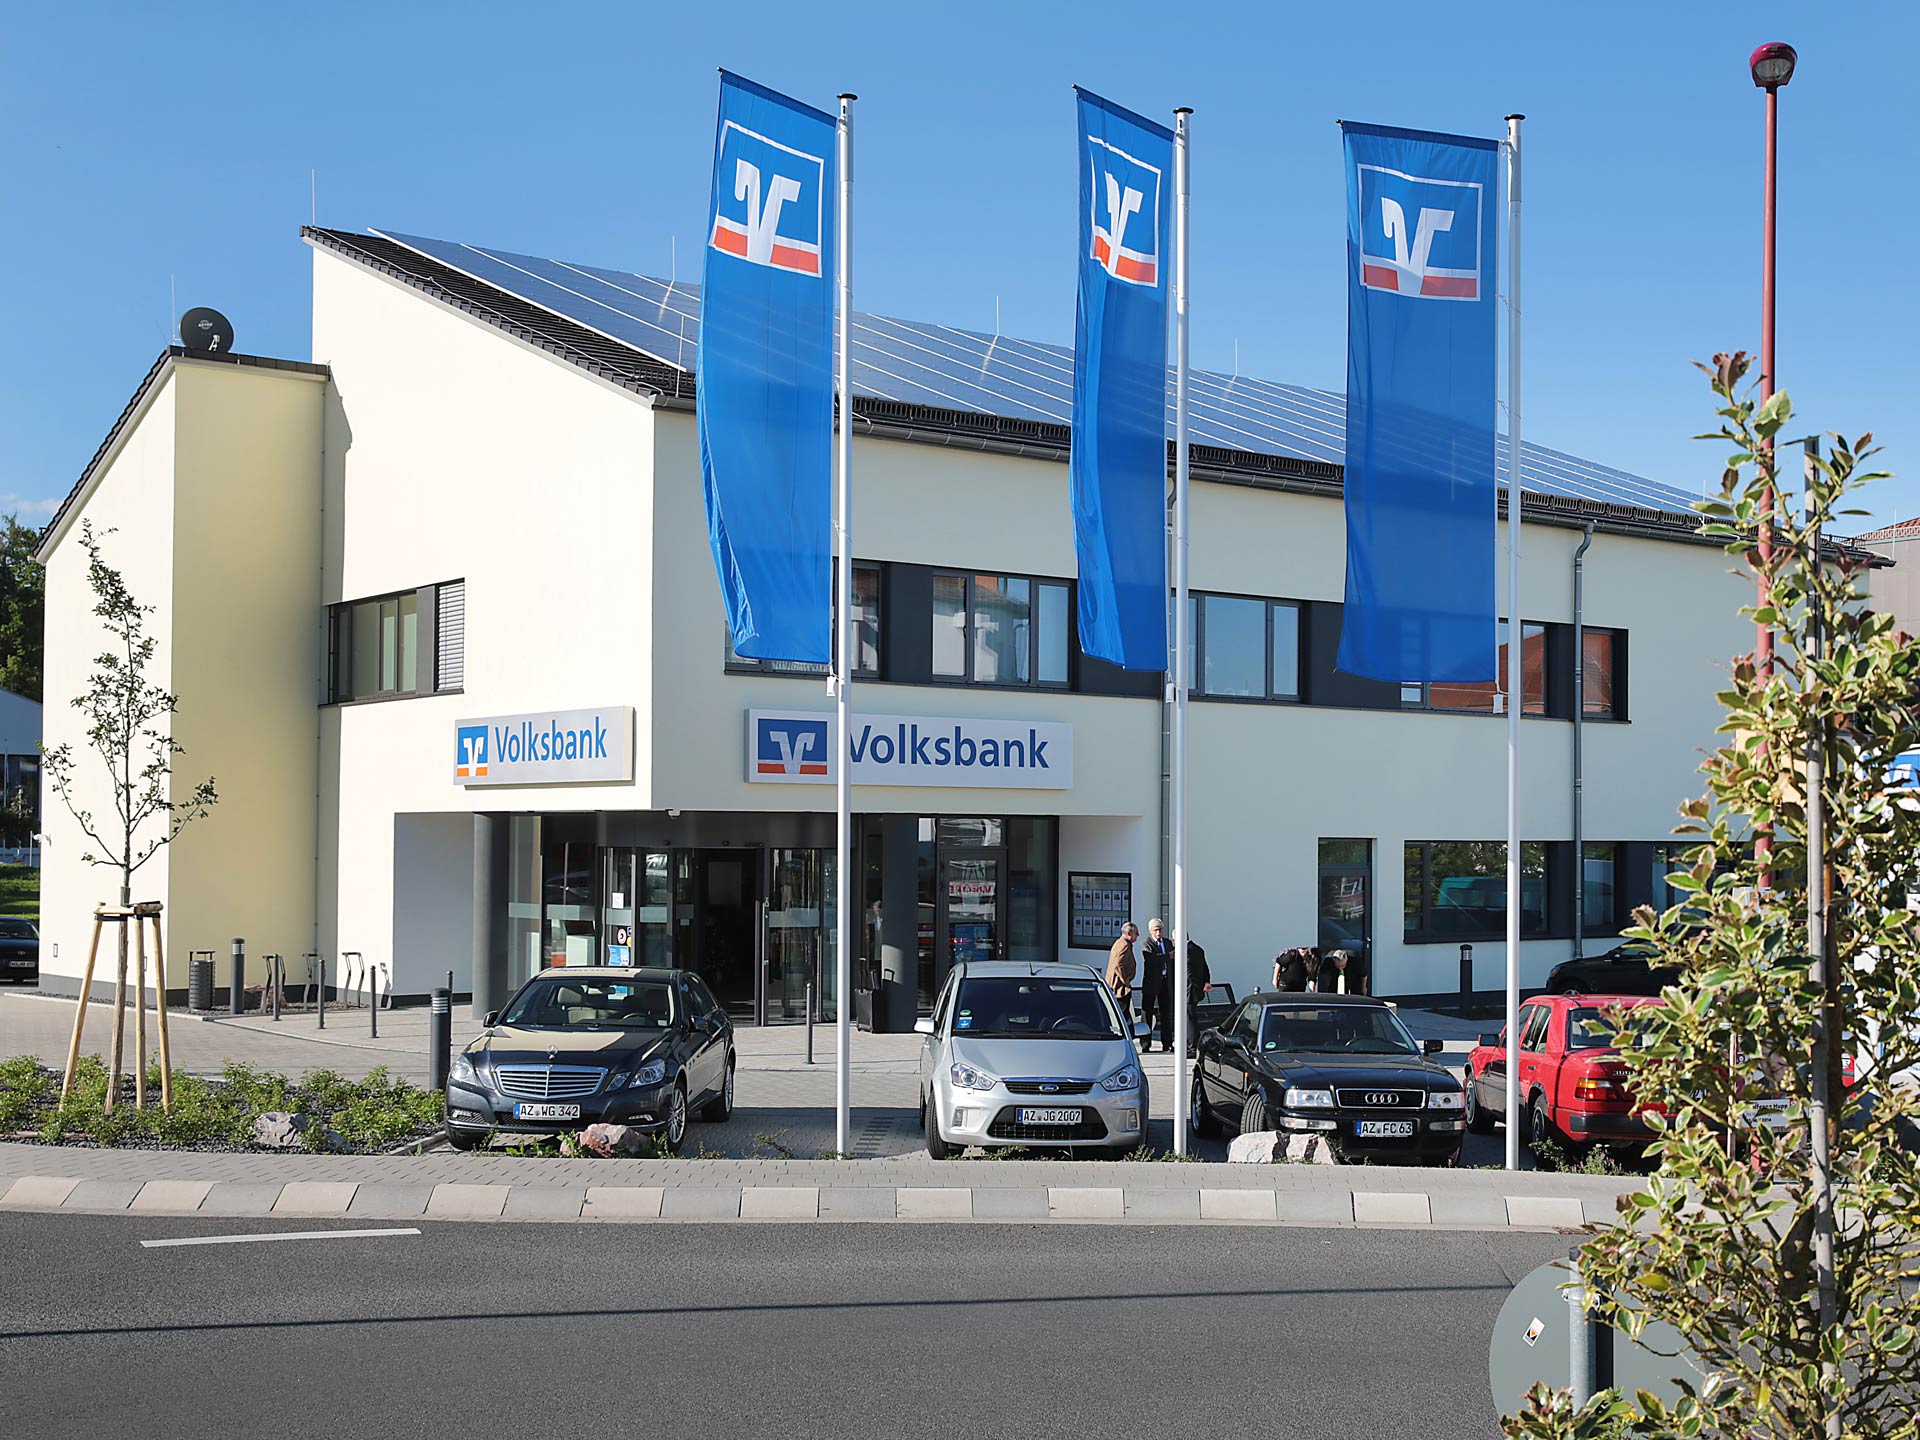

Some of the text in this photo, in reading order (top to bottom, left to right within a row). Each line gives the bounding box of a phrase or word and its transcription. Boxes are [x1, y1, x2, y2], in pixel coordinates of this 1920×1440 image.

[494, 715, 608, 763] Volksbank
[849, 723, 1050, 769] Volksbank
[520, 1105, 579, 1117] AZ WG 342
[1023, 1110, 1081, 1122] AZ JG 2007
[1362, 1122, 1412, 1134] AZ FC 63
